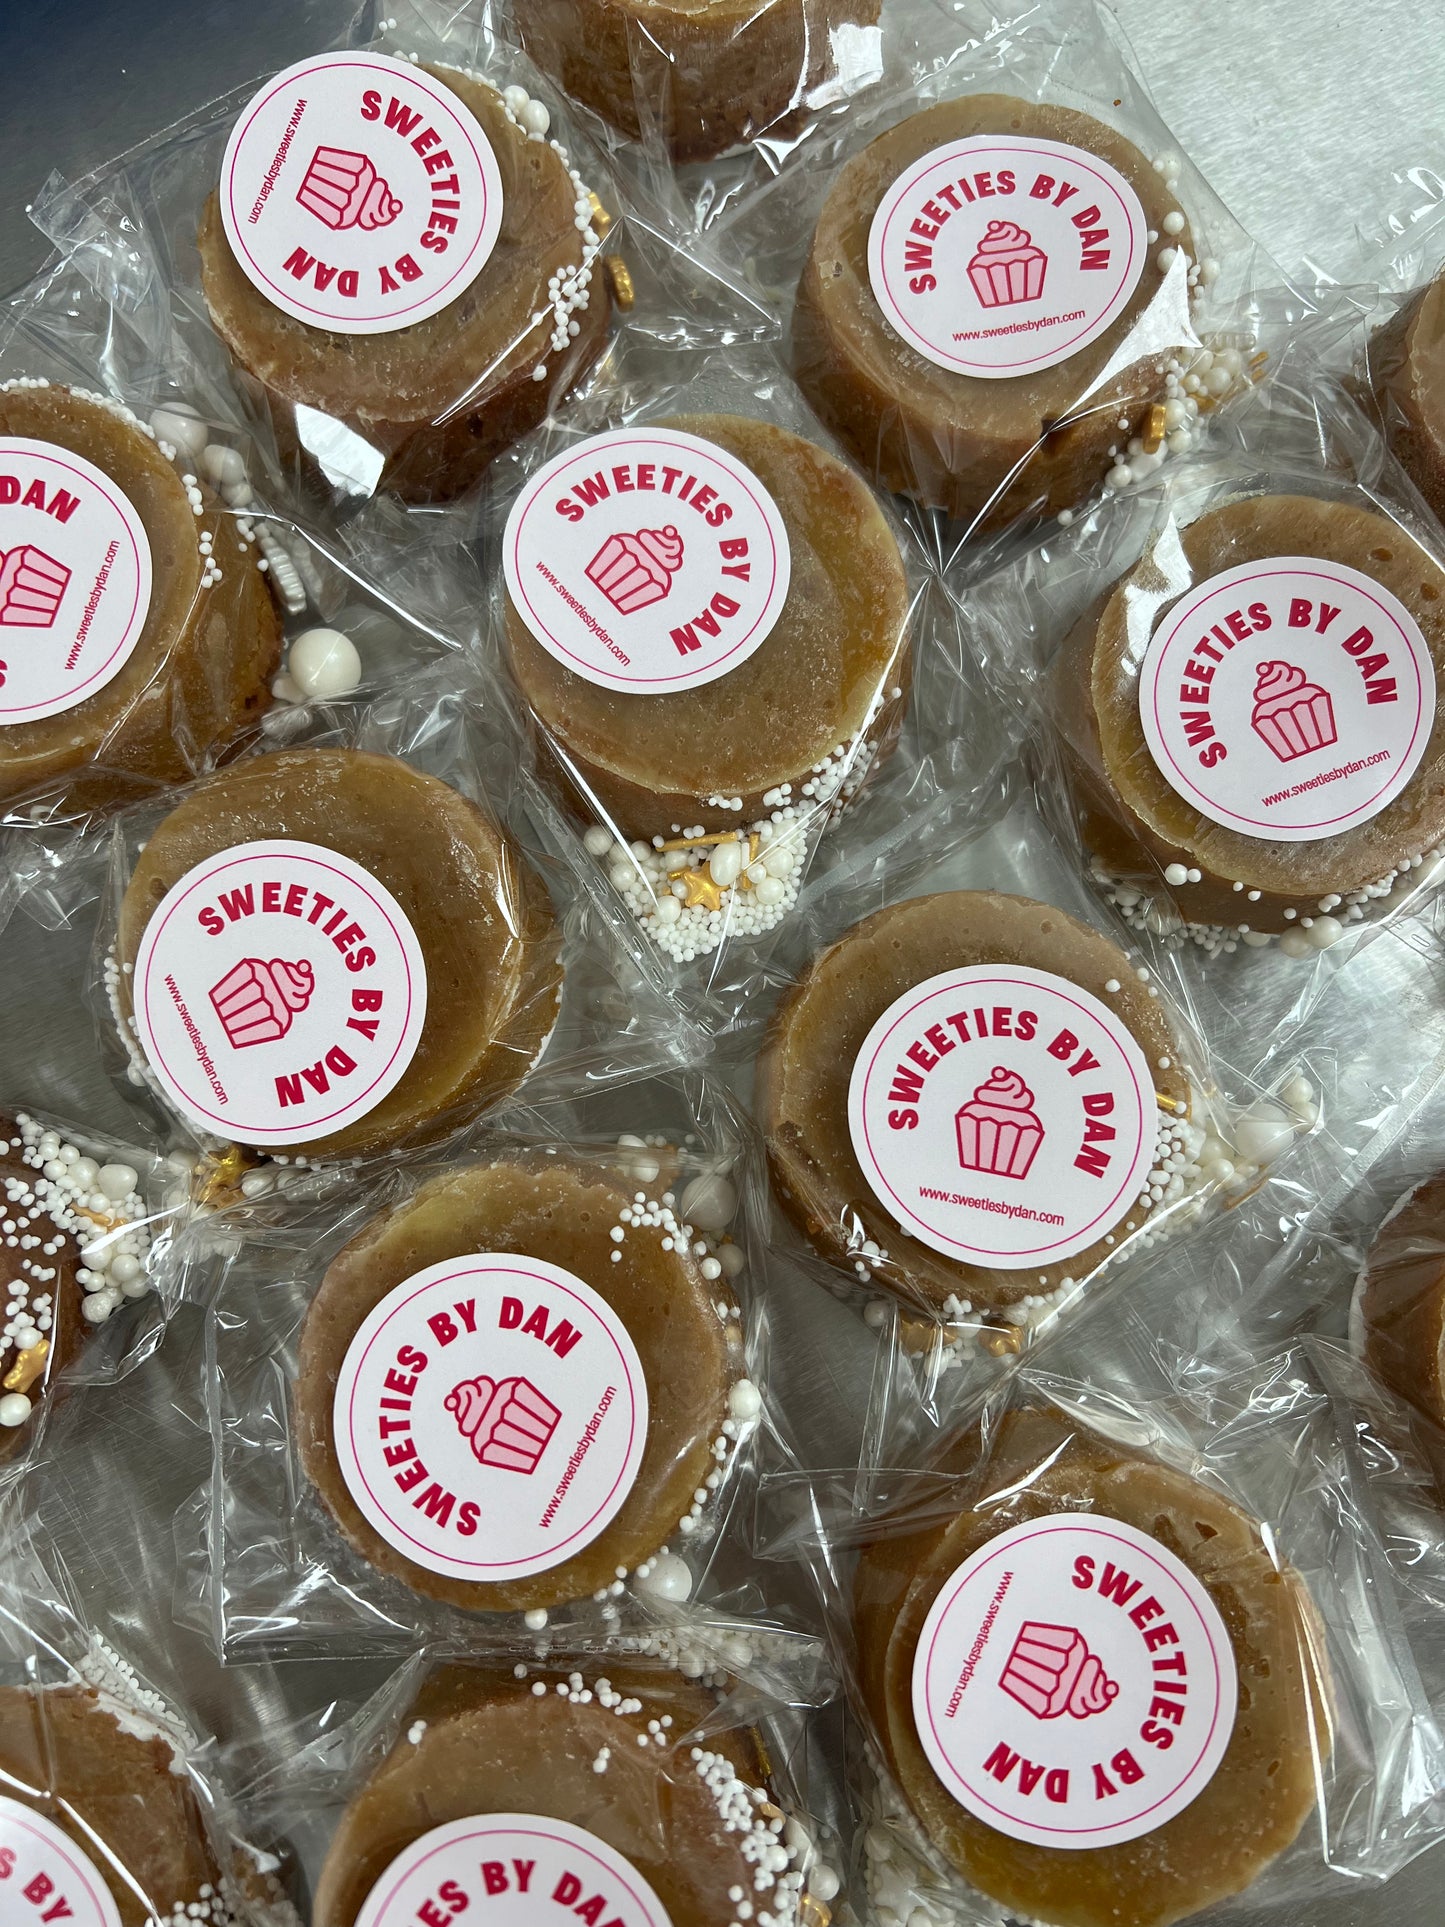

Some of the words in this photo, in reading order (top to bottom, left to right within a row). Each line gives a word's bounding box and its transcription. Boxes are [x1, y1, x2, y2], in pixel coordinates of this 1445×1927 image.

[360, 89, 461, 254] SWEETIES
[905, 171, 1016, 294] SWEETIES
[1030, 175, 1079, 207] BY
[1071, 205, 1110, 271] DAN
[282, 246, 359, 300] DAN
[378, 253, 423, 295] BY
[0, 475, 81, 524] DAN
[555, 462, 733, 527] SWEETIES
[719, 538, 751, 582] BY
[669, 593, 740, 656] DAN
[1180, 602, 1272, 768] SWEETIES
[1288, 598, 1341, 634] BY
[1342, 626, 1398, 705] DAN
[197, 881, 377, 973] SWEETIES
[345, 988, 384, 1041] BY
[274, 1045, 358, 1108] DAN
[887, 1007, 1037, 1131] SWEETIES
[1047, 1028, 1100, 1077] BY
[1073, 1092, 1117, 1179] DAN
[427, 1298, 477, 1347] BY
[498, 1296, 583, 1359] DAN
[378, 1345, 481, 1537] SWEETIES
[1071, 1555, 1188, 1750] SWEETIES
[983, 1742, 1070, 1804] DAN
[1092, 1748, 1145, 1800] BY
[23, 1872, 73, 1923] BY
[481, 1859, 535, 1896] BY
[552, 1871, 627, 1927] DA
